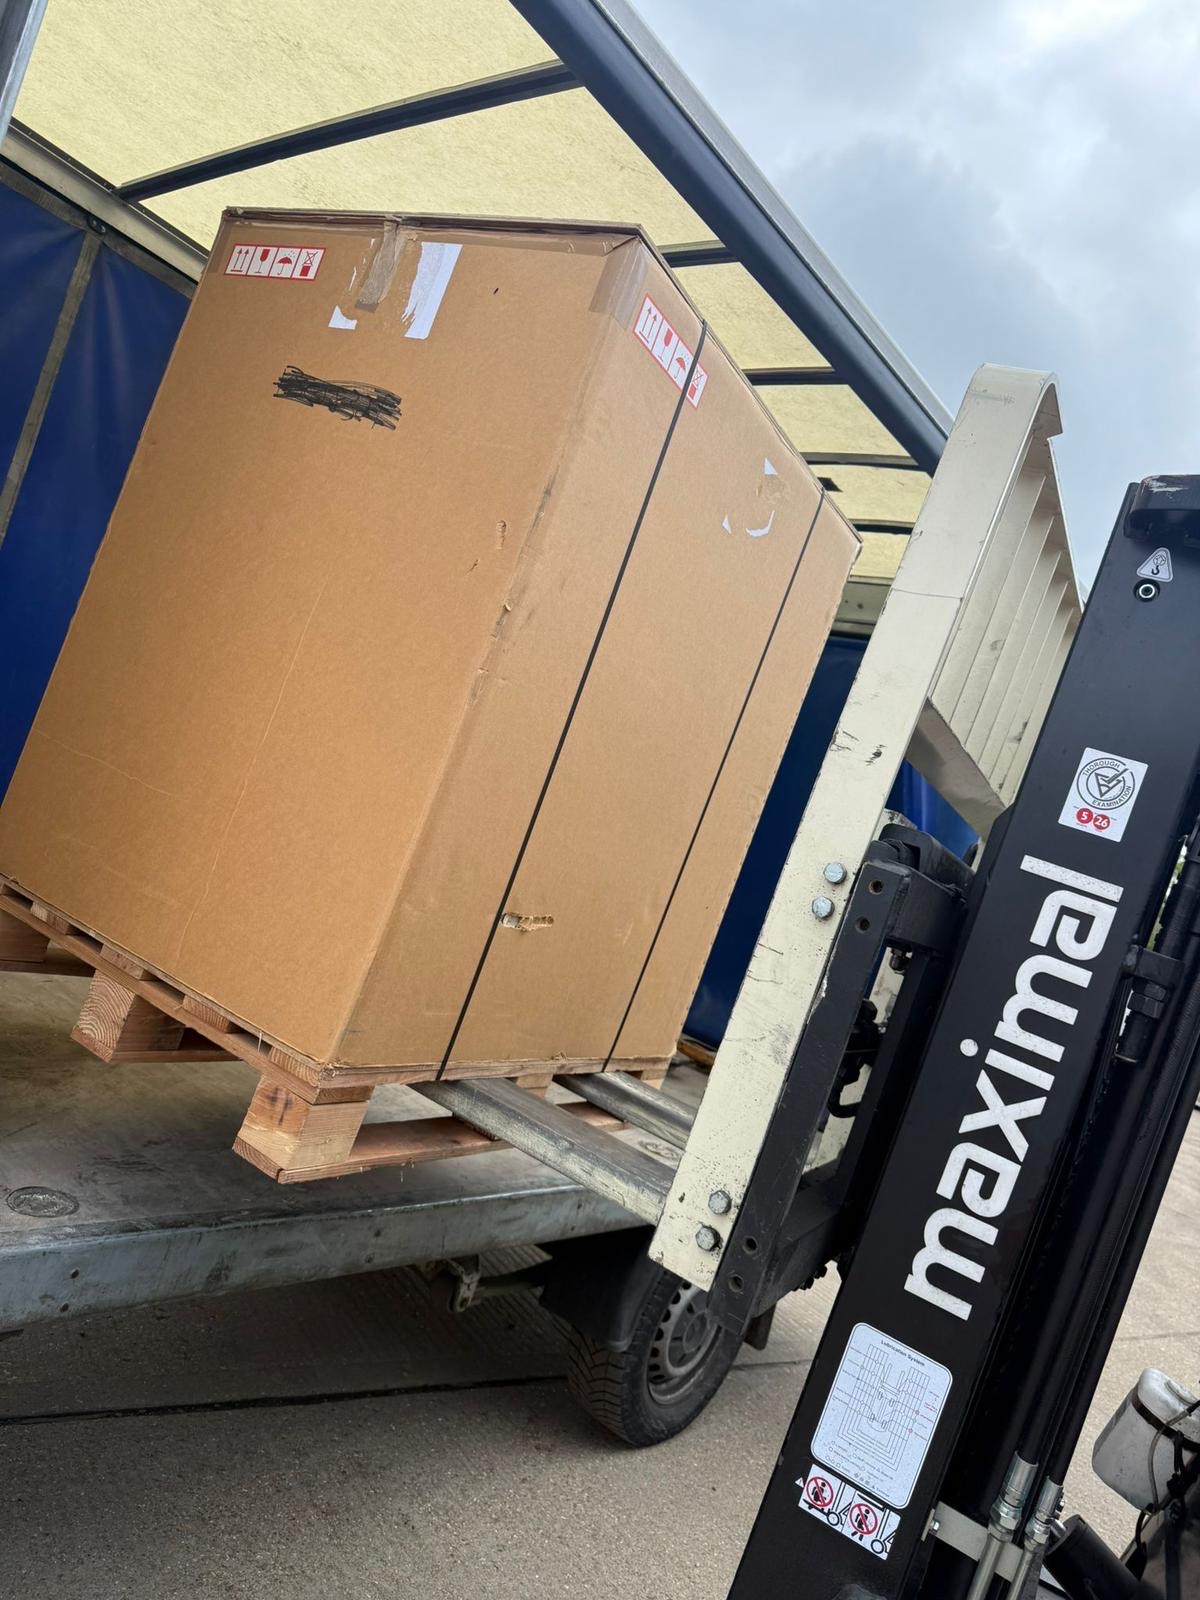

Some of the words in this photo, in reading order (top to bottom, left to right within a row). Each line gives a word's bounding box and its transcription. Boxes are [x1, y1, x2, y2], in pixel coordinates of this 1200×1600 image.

[1082, 760, 1121, 776] THOROUGH
[1092, 786, 1132, 807] EXAMINATION
[1081, 811, 1089, 821] 5
[1095, 816, 1108, 828] 26
[904, 854, 1124, 1321] maximal
